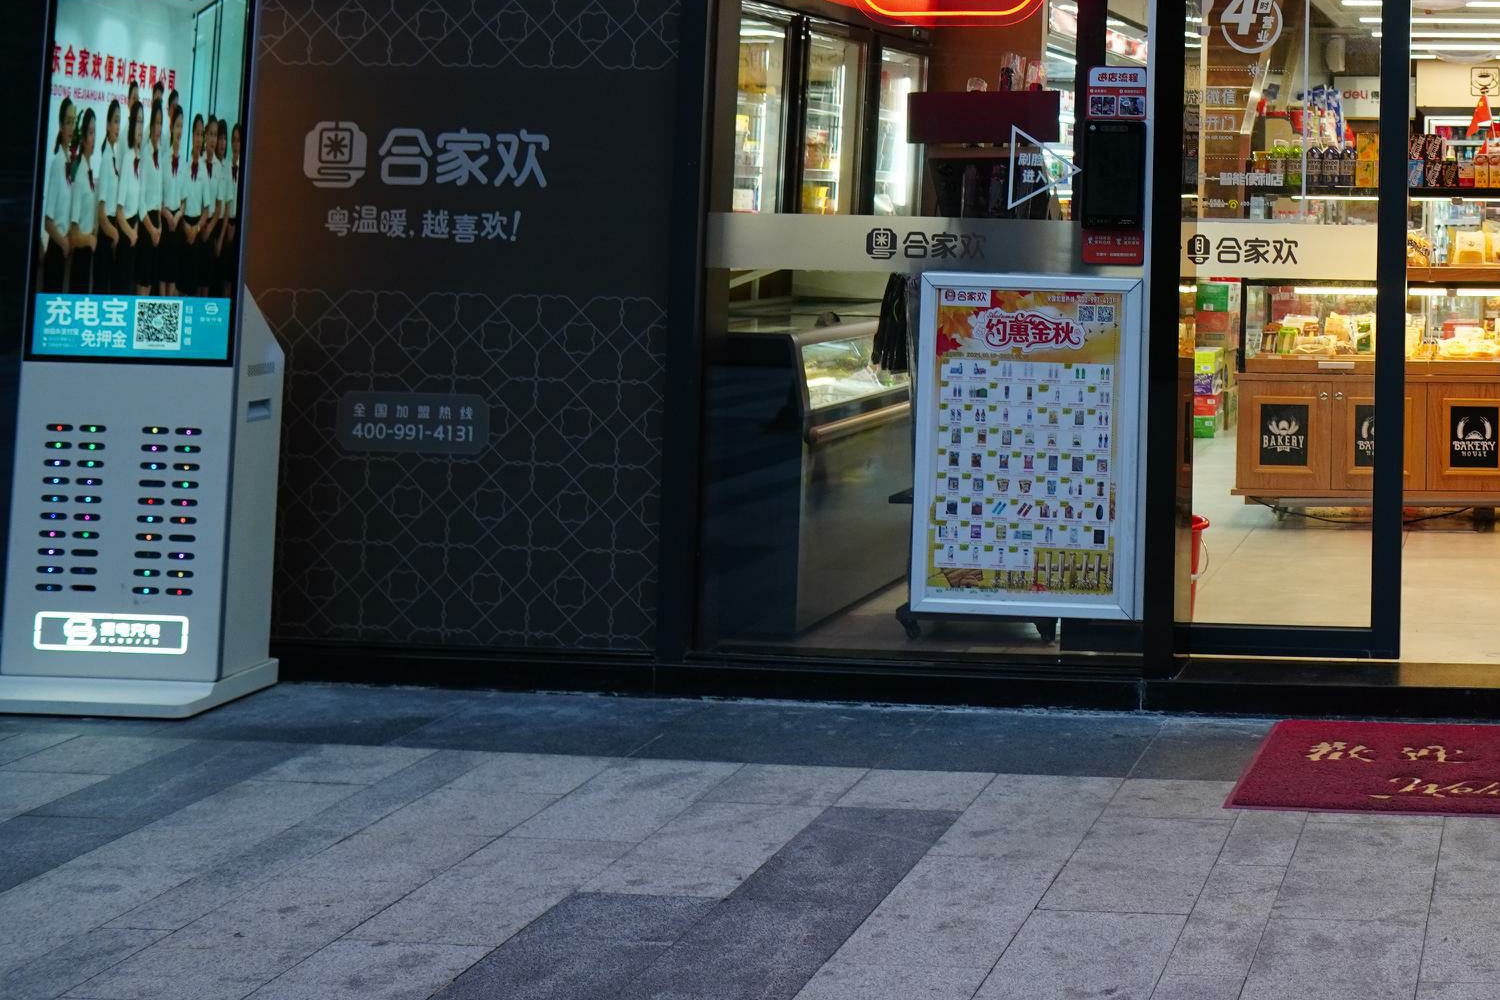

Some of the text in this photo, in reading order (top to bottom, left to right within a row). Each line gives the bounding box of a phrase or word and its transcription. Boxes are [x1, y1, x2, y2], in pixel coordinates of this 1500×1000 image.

[1343, 89, 1368, 100] deli
[378, 127, 550, 188] 合家欢
[902, 231, 988, 260] 合家欢
[1215, 236, 1299, 265] 合家欢
[957, 290, 988, 302] 合家欢
[44, 296, 128, 327] 充电宝
[80, 329, 128, 349] 免押金
[985, 315, 1080, 347] 约惠金秋
[353, 402, 474, 421] 全国加盟热线
[352, 424, 474, 442] 400-991-4131
[1262, 434, 1305, 448] BAKERY
[1452, 441, 1496, 451] BAKERY
